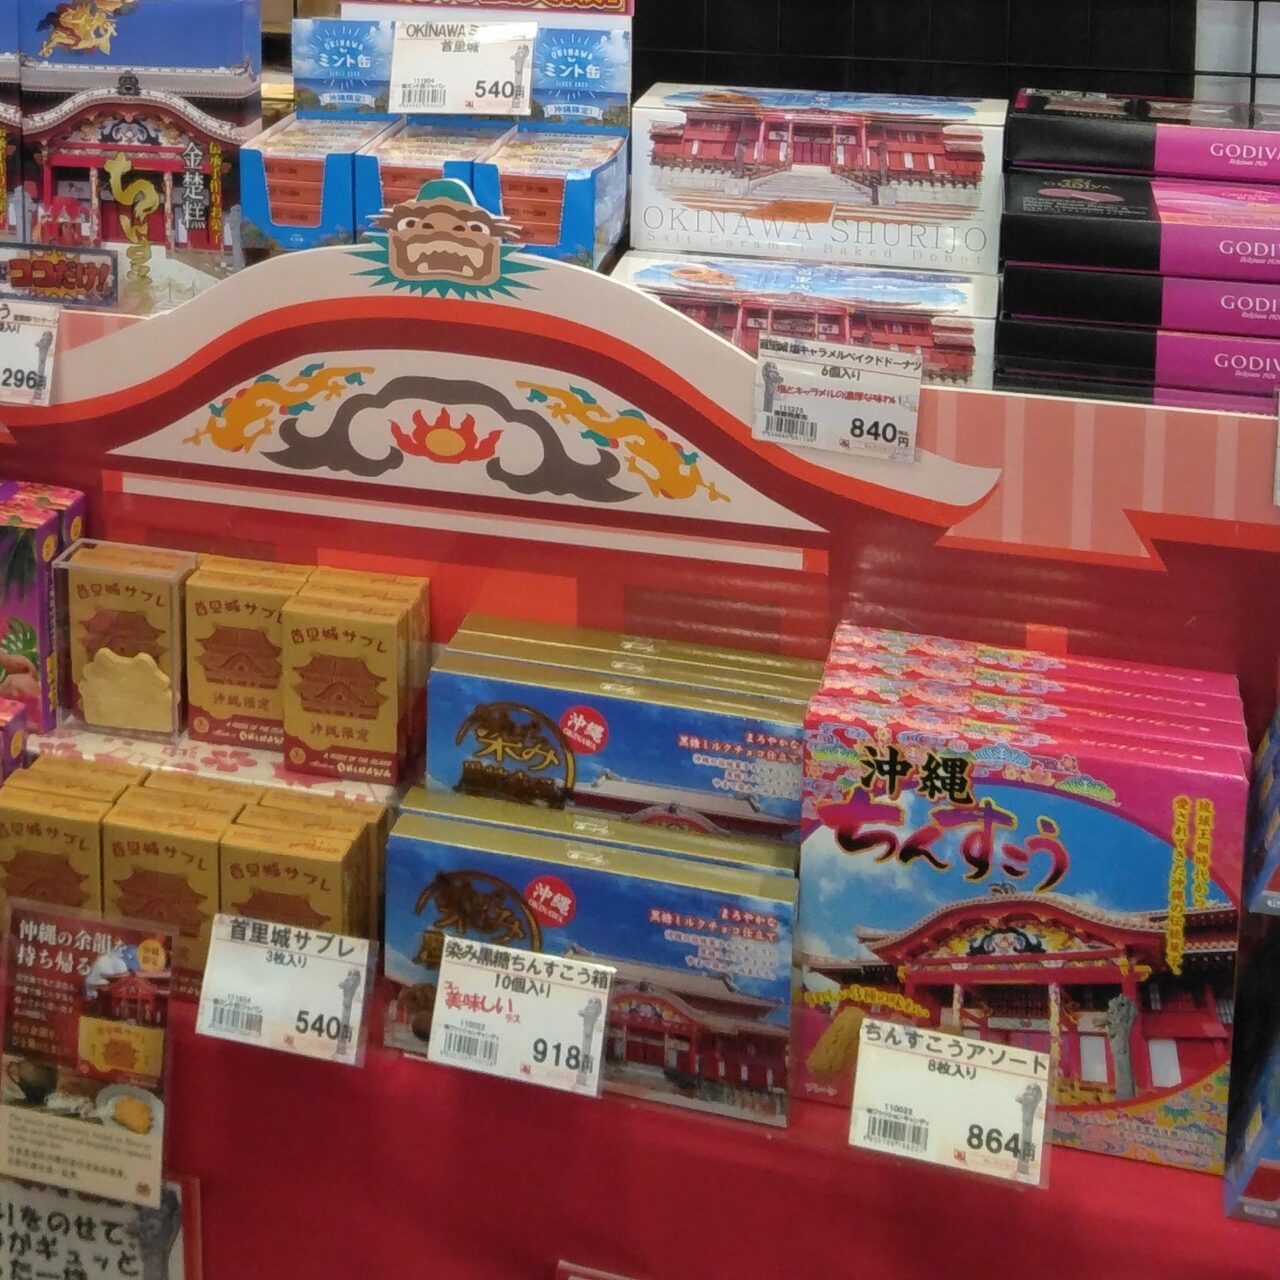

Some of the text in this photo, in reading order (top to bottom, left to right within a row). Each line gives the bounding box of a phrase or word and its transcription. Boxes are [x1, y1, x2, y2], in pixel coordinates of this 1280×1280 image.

[324, 40, 364, 51] OKINAWA
[440, 40, 480, 53] 首里城
[551, 48, 594, 60] OKINAWA
[319, 53, 372, 68] ミント缶
[544, 63, 600, 79] ミント缶
[182, 142, 206, 229] 金楚糕
[642, 206, 988, 255] OKINAWA SHURIJO
[824, 244, 892, 260] Baked
[912, 251, 981, 266] Donut
[1219, 240, 1280, 257] GODI
[821, 367, 861, 381] 6個入り
[77, 583, 166, 608] 首里城サブレ
[291, 626, 388, 653] 首里城サブレ
[568, 712, 606, 744] 沖縄
[860, 745, 974, 806] 沖縄
[817, 788, 1069, 892] ちんすこう
[112, 840, 208, 872] 首里城サブレ
[228, 863, 331, 892] 首里城サブレ
[532, 882, 571, 915] 沖縄
[230, 918, 355, 958] 首里城サブレ
[16, 944, 92, 976] 持ち帰る
[265, 950, 308, 968] 3枚入り
[445, 940, 608, 990] 染み黒糖ちんすこう箱
[494, 973, 552, 999] 10個入り
[865, 1022, 1047, 1075] ちんすこうアソート
[927, 1059, 977, 1080] 8枚入り
